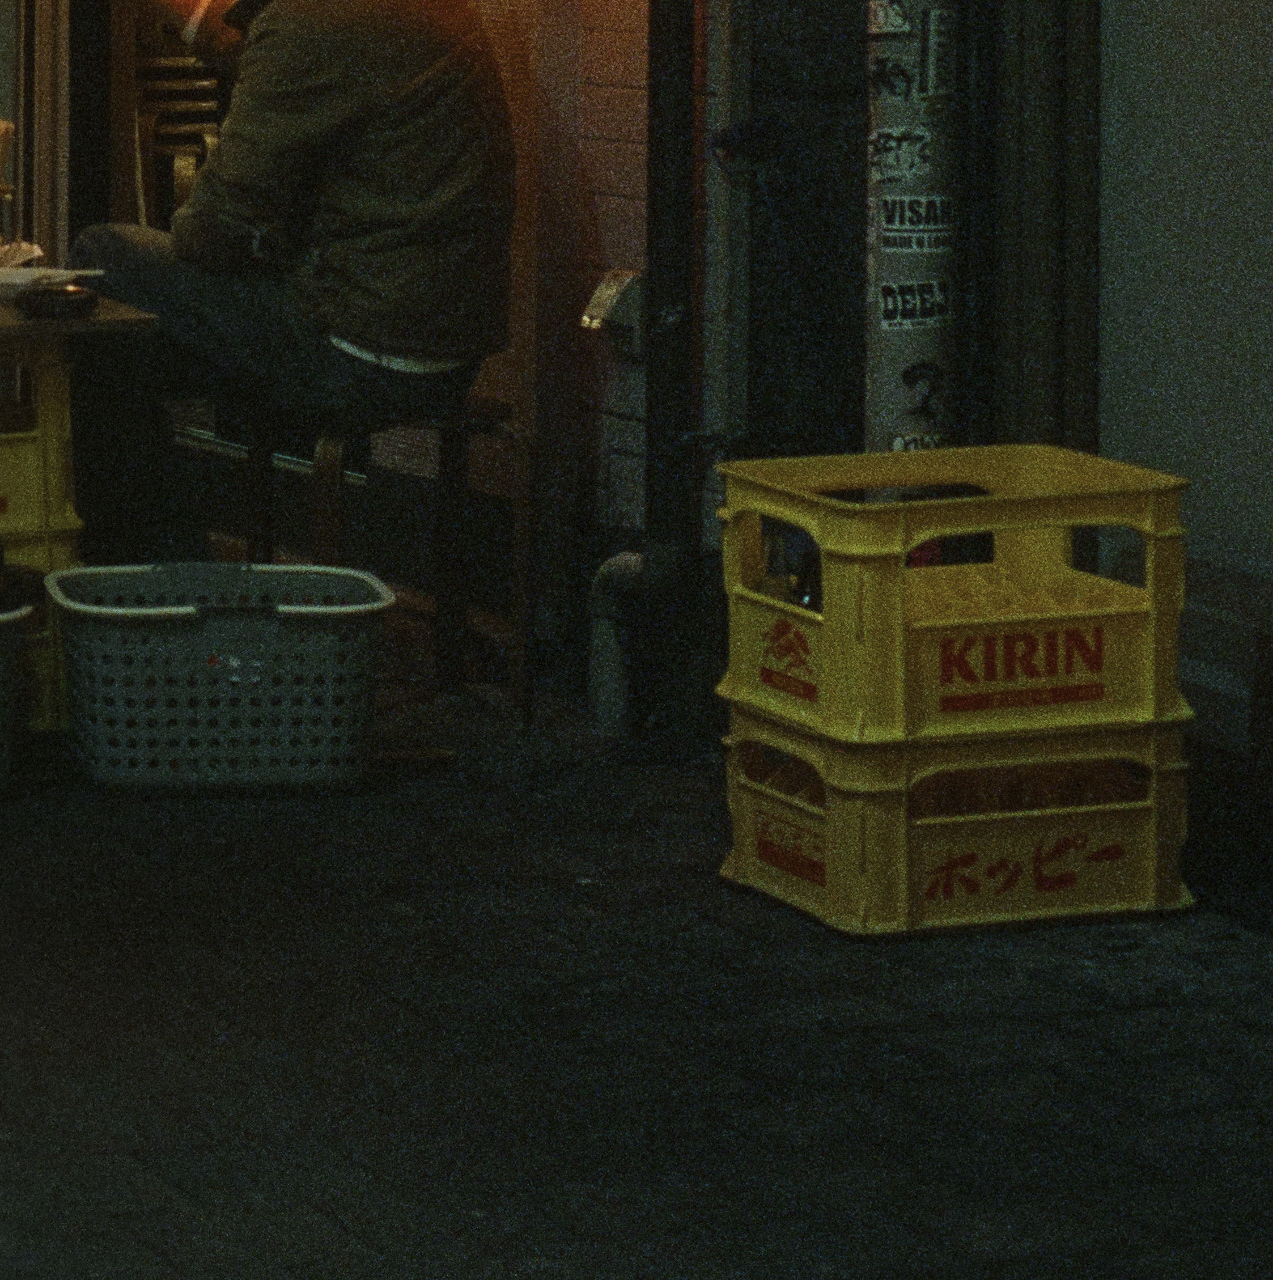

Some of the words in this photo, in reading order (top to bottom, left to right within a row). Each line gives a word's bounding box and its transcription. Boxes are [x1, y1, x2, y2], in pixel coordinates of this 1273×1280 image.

[940, 626, 1105, 686] KIRIN
[927, 834, 1124, 902] ホッピー
